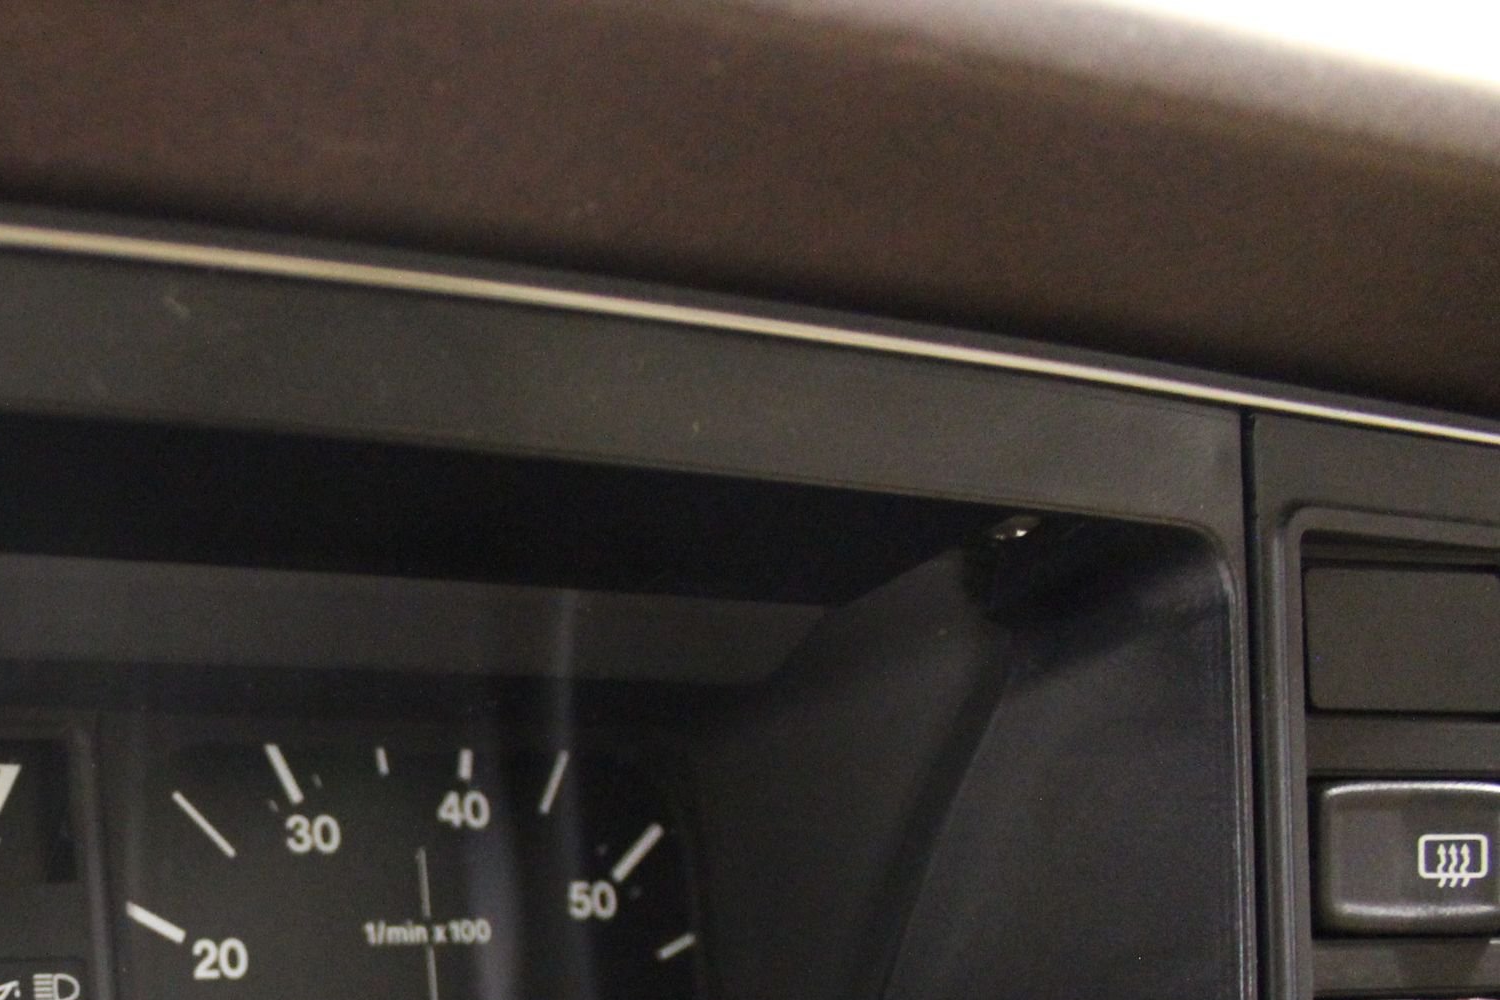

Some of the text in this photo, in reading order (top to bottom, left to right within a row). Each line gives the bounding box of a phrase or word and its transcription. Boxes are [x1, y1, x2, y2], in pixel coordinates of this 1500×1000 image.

[437, 790, 491, 830] 40
[285, 814, 341, 854] 30
[567, 879, 620, 920] 50
[448, 918, 491, 944] 100
[192, 937, 249, 980] 20
